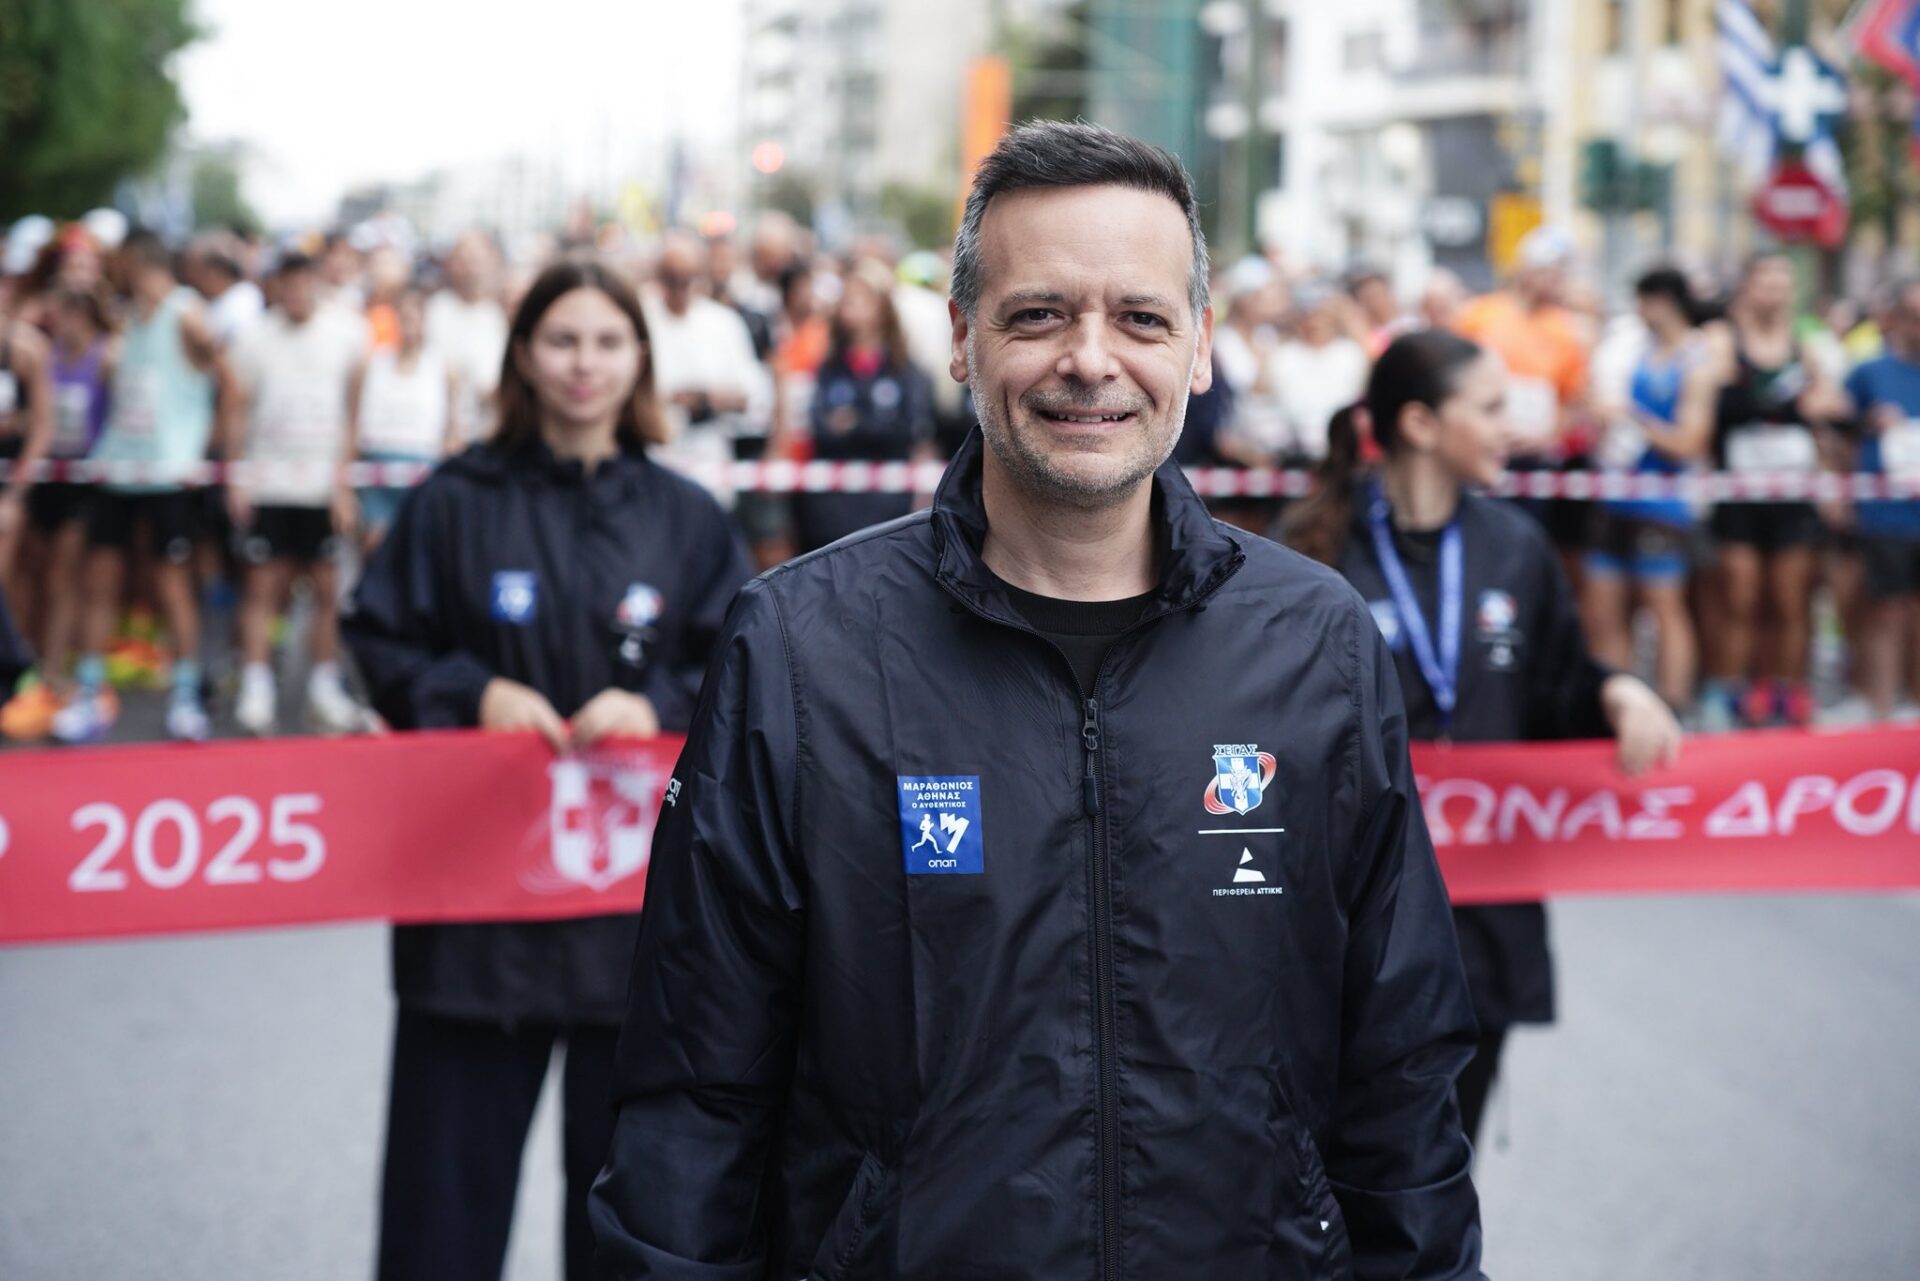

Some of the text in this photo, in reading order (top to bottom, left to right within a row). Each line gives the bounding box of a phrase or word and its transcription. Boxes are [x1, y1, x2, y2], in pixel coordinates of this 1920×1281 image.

[1213, 744, 1258, 756] ΣΕΓΑΣ
[903, 782, 974, 791] ΜΑΡΑΘΩΝΙΟΣ
[917, 791, 961, 801] ΑΘΗΝΑΣ
[1414, 768, 1920, 846] ΩΝΑΣ ΔΡΟ
[68, 794, 327, 893] 2025
[1212, 887, 1283, 896] ΠΕΡΙΦΕΡΕΙΑ ΑΤΤΙΚΗΣ
